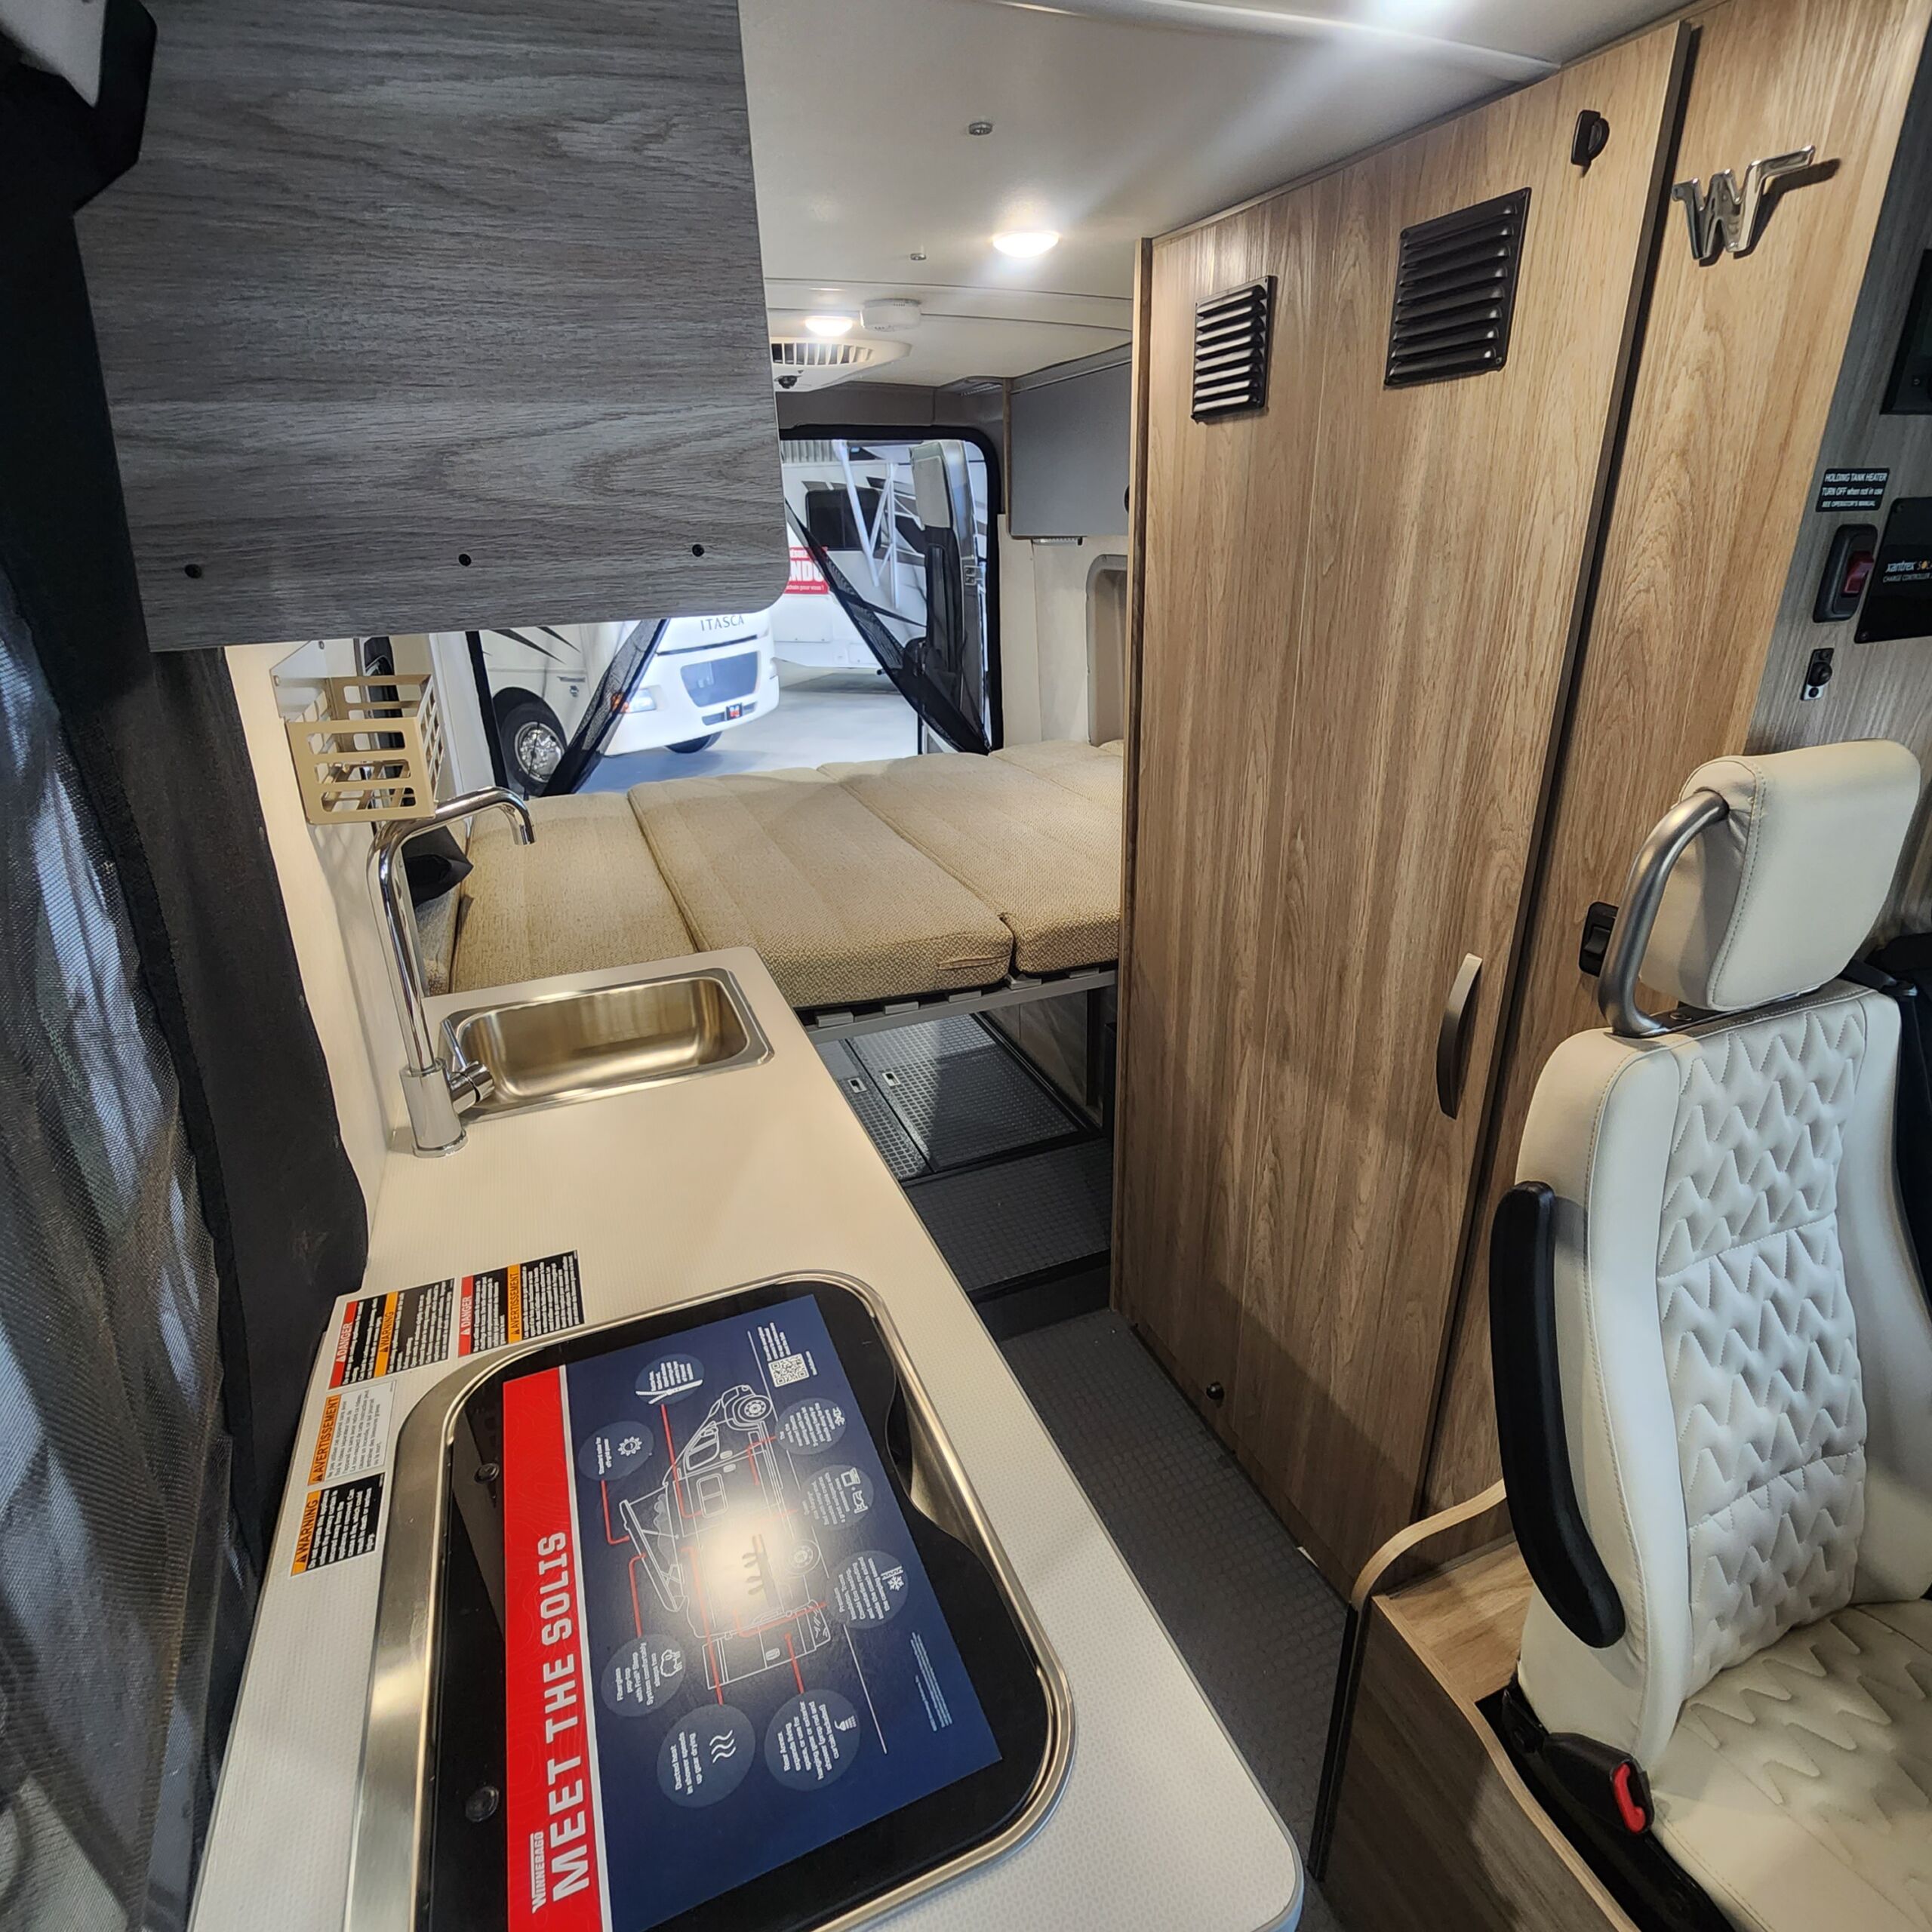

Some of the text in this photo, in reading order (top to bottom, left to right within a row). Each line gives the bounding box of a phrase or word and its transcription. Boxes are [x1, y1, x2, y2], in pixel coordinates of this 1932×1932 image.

[1825, 473, 1850, 481] HOLDING
[1866, 473, 1887, 481] HEATER
[1823, 488, 1836, 496] TURN
[1885, 561, 1916, 573] xantrex
[700, 615, 744, 631] ITASCA
[461, 1295, 471, 1327] DANGER
[510, 1273, 519, 1328] AVERTISSEMENT
[337, 1321, 352, 1355] DANGER
[380, 1312, 393, 1347] WARNING
[313, 1398, 338, 1473] AVERTISSEMENT
[297, 1500, 318, 1552] WARNING
[640, 1642, 654, 1705] System comfortably
[635, 1687, 643, 1703] with
[538, 1532, 589, 1901] MEET THE SOLIS
[792, 1715, 800, 1727] for
[678, 1732, 688, 1758] speeds
[776, 1732, 790, 1770] Rear Annex
[786, 1722, 801, 1770] expands living
[799, 1739, 804, 1747] or
[800, 1702, 823, 1780] hanging gear or exterior
[829, 1734, 839, 1758] curtain
[821, 1745, 832, 1770] shower
[672, 1762, 681, 1790] Ducted
[686, 1786, 693, 1794] in
[697, 1774, 702, 1784] up
[530, 1831, 545, 1913] WINNEBAGO
